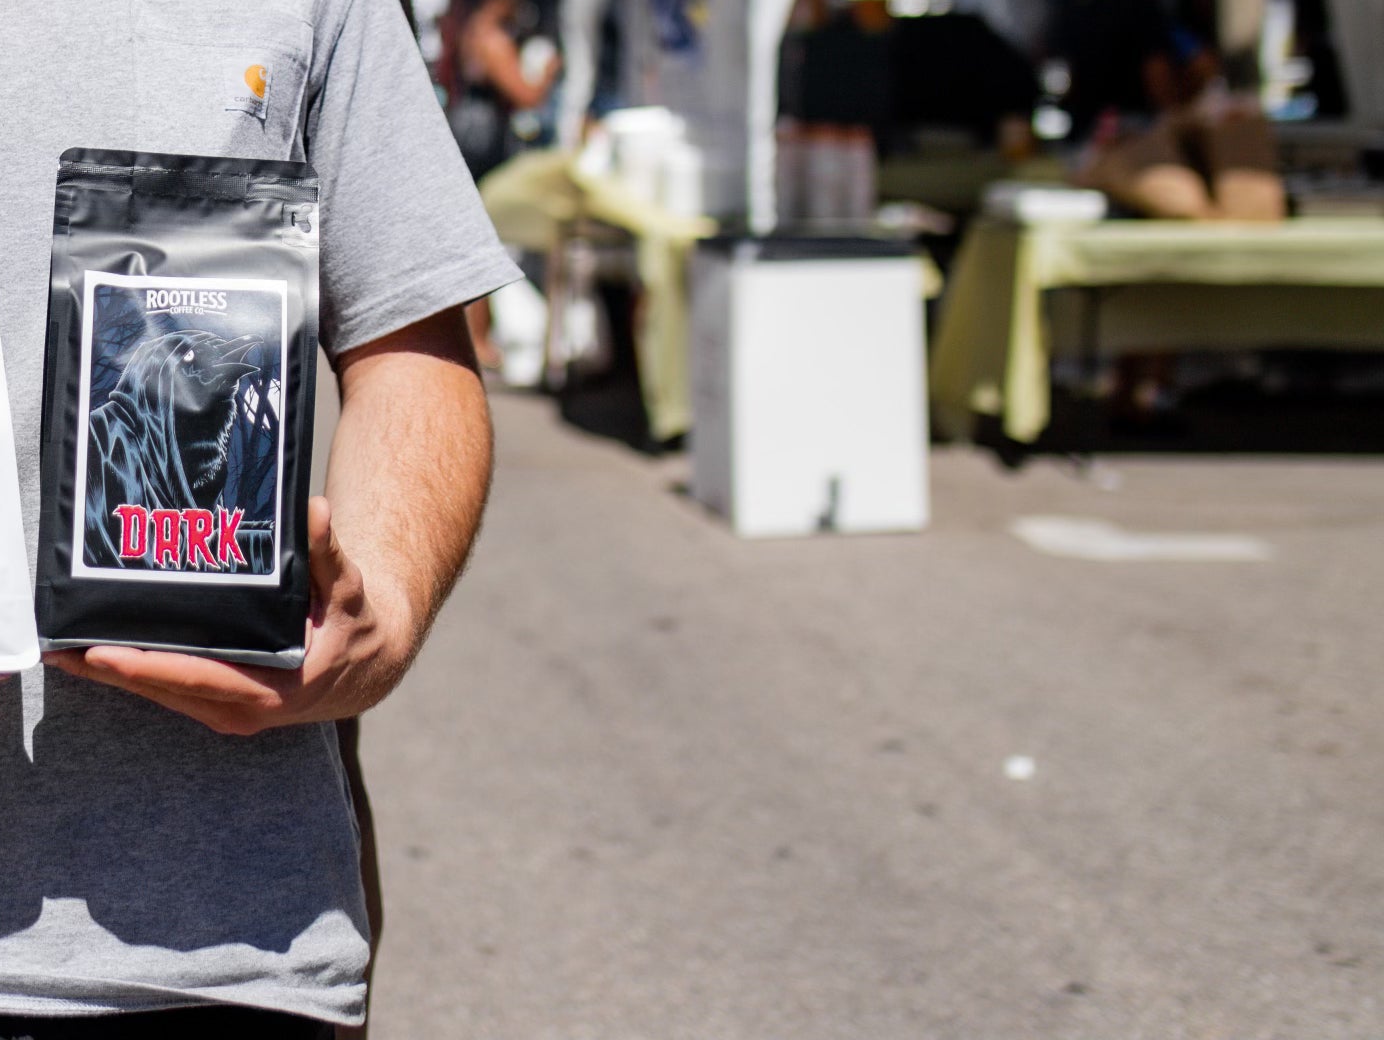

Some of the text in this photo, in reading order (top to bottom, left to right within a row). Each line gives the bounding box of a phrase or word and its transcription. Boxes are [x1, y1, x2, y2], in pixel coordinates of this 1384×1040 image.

[146, 289, 228, 310] ROOTLESS
[169, 306, 193, 314] COFFEE
[112, 503, 248, 570] DARK
